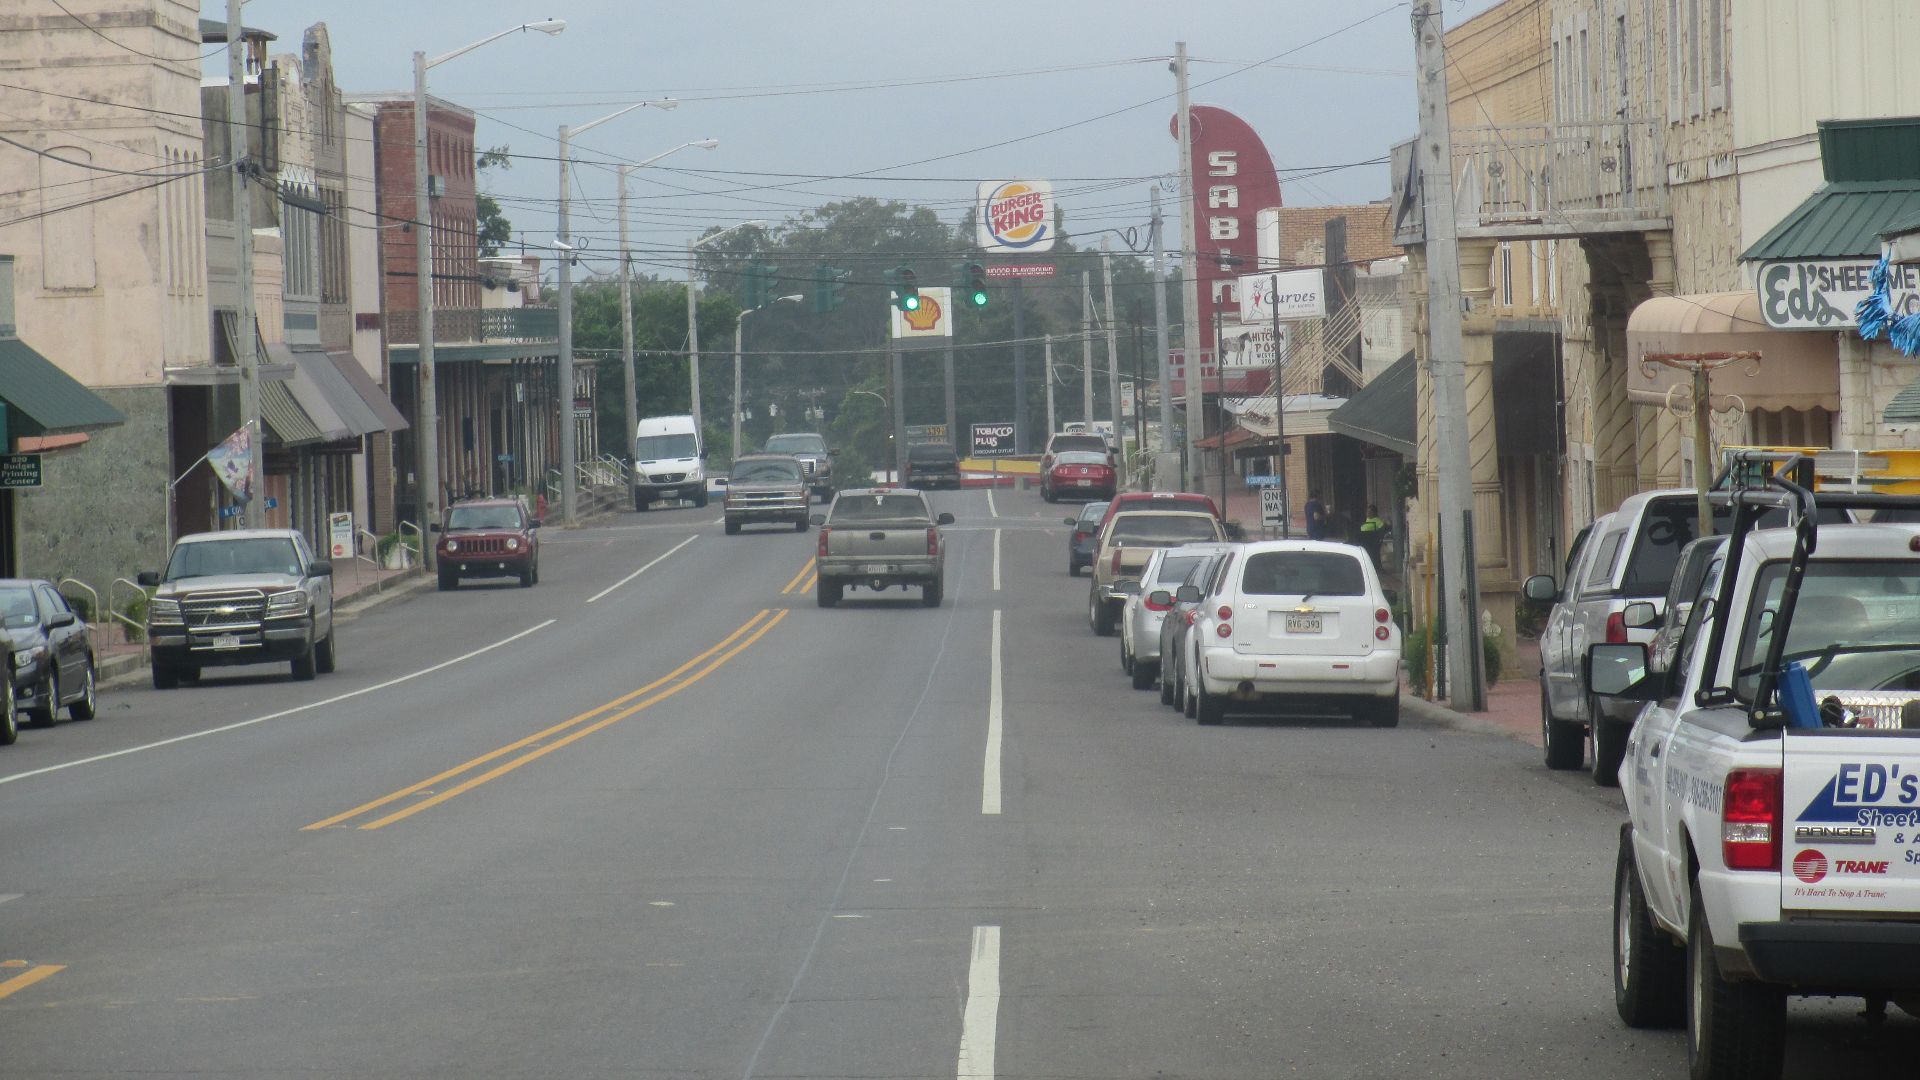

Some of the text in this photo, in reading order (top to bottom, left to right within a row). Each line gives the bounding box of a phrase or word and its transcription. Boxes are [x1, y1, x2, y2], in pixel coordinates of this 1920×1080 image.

[991, 192, 1041, 218] BURGER
[994, 204, 1044, 235] KING
[1264, 291, 1316, 305] Curves
[1765, 264, 1849, 326] Ed's
[975, 427, 1013, 437] TOBACCO
[975, 437, 998, 447] PLUS
[3, 463, 36, 471] Budget
[1, 470, 38, 478] Printing
[1264, 492, 1281, 501] ON
[1265, 503, 1282, 512] WA
[1306, 619, 1320, 629] 393
[1836, 763, 1919, 804] ED's
[1857, 808, 1917, 827] Sheet
[1796, 826, 1875, 837] RANGER
[1893, 832, 1905, 844] &
[1835, 860, 1890, 874] TRANE
[1794, 888, 1806, 896] It's
[1806, 888, 1826, 897] Hard
[1828, 889, 1837, 897] To
[1839, 888, 1854, 899] Stop
[1855, 889, 1862, 898] A
